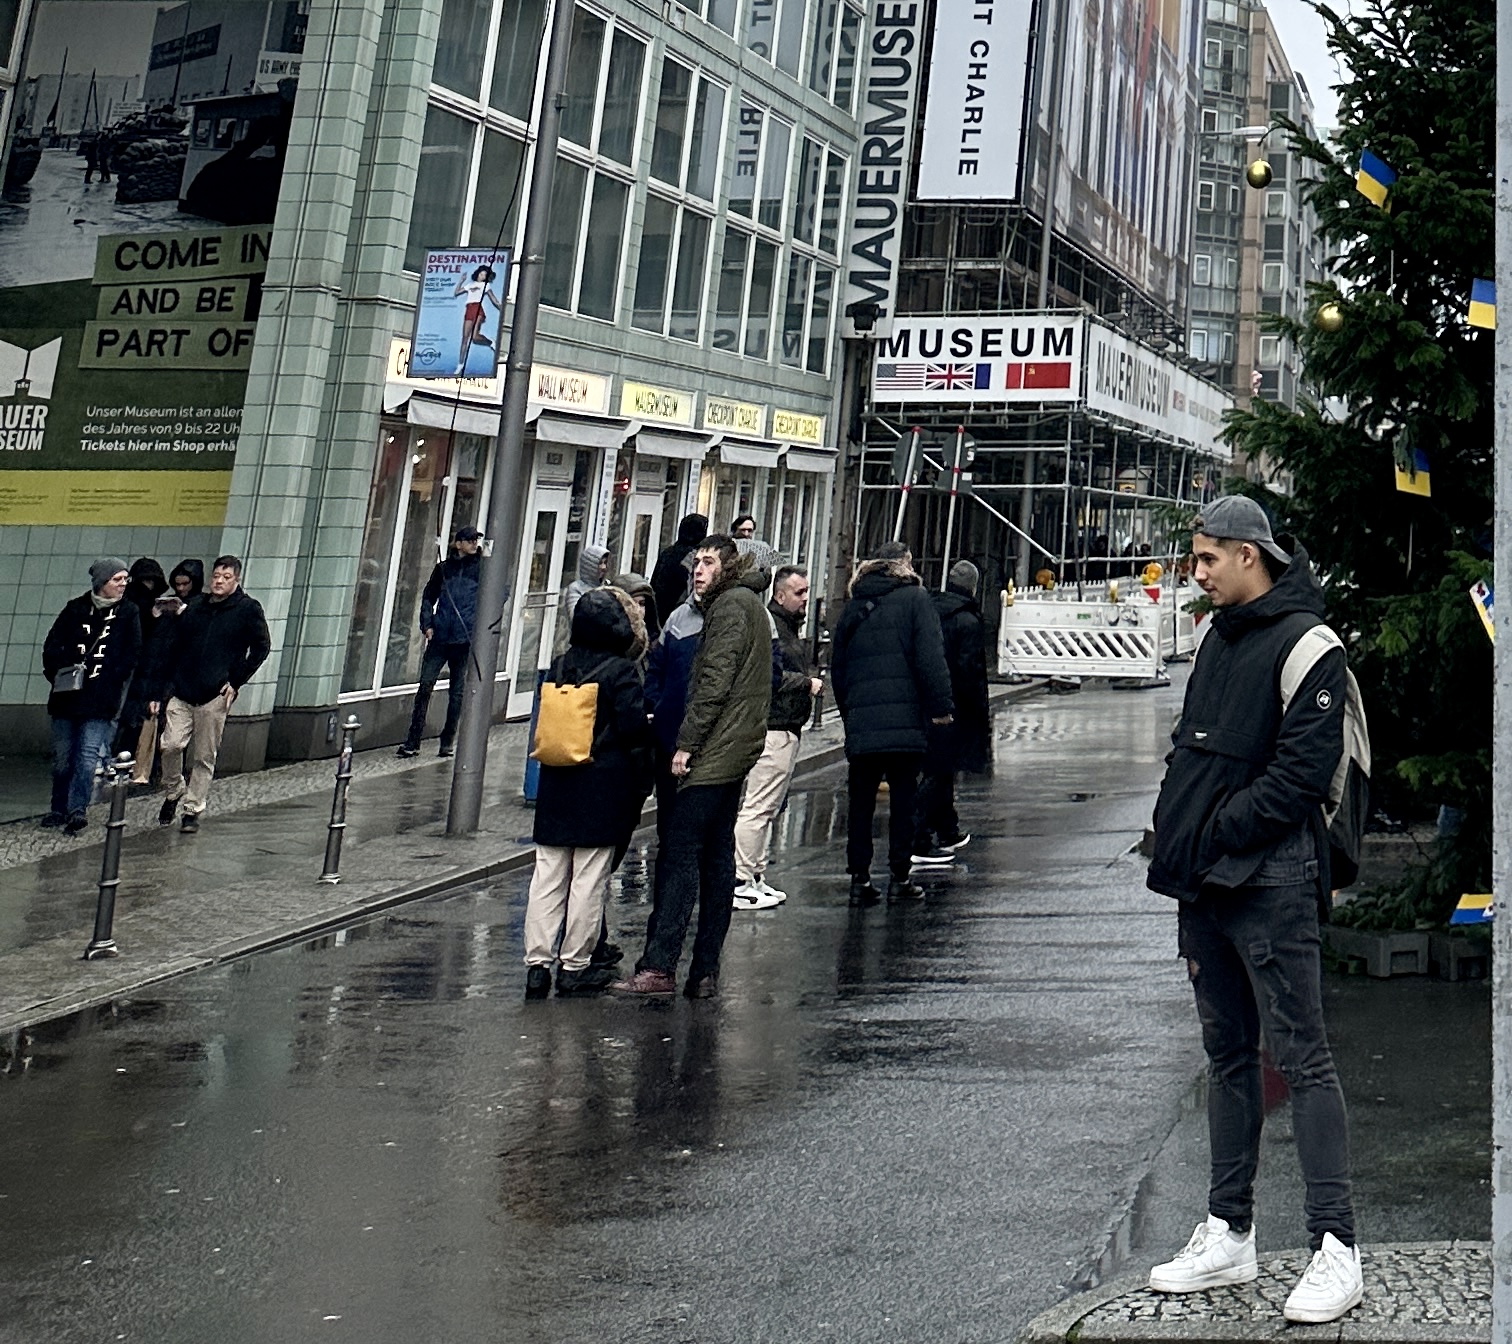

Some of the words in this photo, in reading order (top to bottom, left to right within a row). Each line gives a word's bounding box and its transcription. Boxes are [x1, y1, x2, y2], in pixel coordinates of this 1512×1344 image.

[958, 40, 990, 176] CHARLIE
[115, 236, 222, 271] COME
[428, 254, 505, 264] DESTINATION
[426, 265, 462, 274] STYLE
[110, 288, 180, 315] AND
[196, 286, 236, 313] BE
[96, 329, 190, 358] PART
[208, 328, 253, 357] OF
[878, 327, 1074, 359] MUSEUM
[538, 374, 558, 401] WALL
[558, 378, 588, 404] MUSEUM
[1096, 340, 1171, 419] MAUERMUSEUM
[86, 406, 123, 418] Unser
[125, 406, 177, 418] Museum
[179, 407, 193, 418] ist
[195, 408, 211, 418] an
[634, 391, 679, 418] MAUERMUSEUM
[83, 423, 105, 435] des
[106, 423, 148, 435] Jahres
[150, 425, 172, 435] von
[174, 423, 182, 435] 9
[185, 423, 203, 435] bis
[205, 423, 221, 435] 22
[81, 439, 126, 451] Tickets
[128, 440, 153, 451] hier
[154, 440, 170, 451] im
[172, 439, 205, 454] Shop
